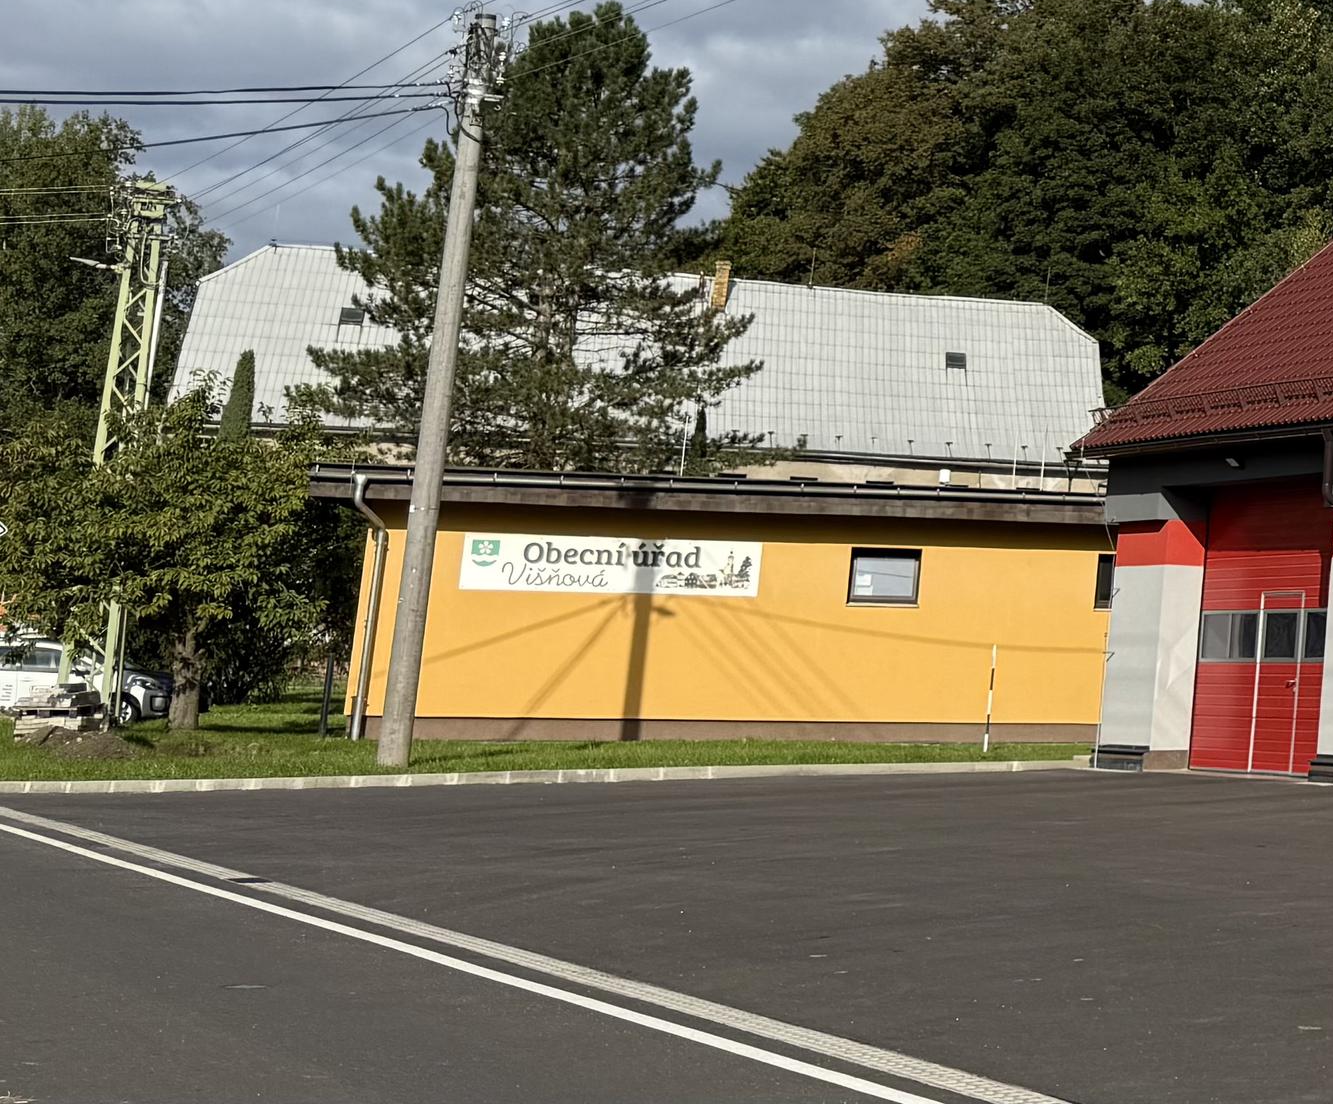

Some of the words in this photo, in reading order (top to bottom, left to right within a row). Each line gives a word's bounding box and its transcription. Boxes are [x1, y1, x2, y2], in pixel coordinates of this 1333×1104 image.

[523, 541, 625, 566] Obecní
[632, 542, 702, 569] úřad
[501, 561, 609, 588] Višňová
